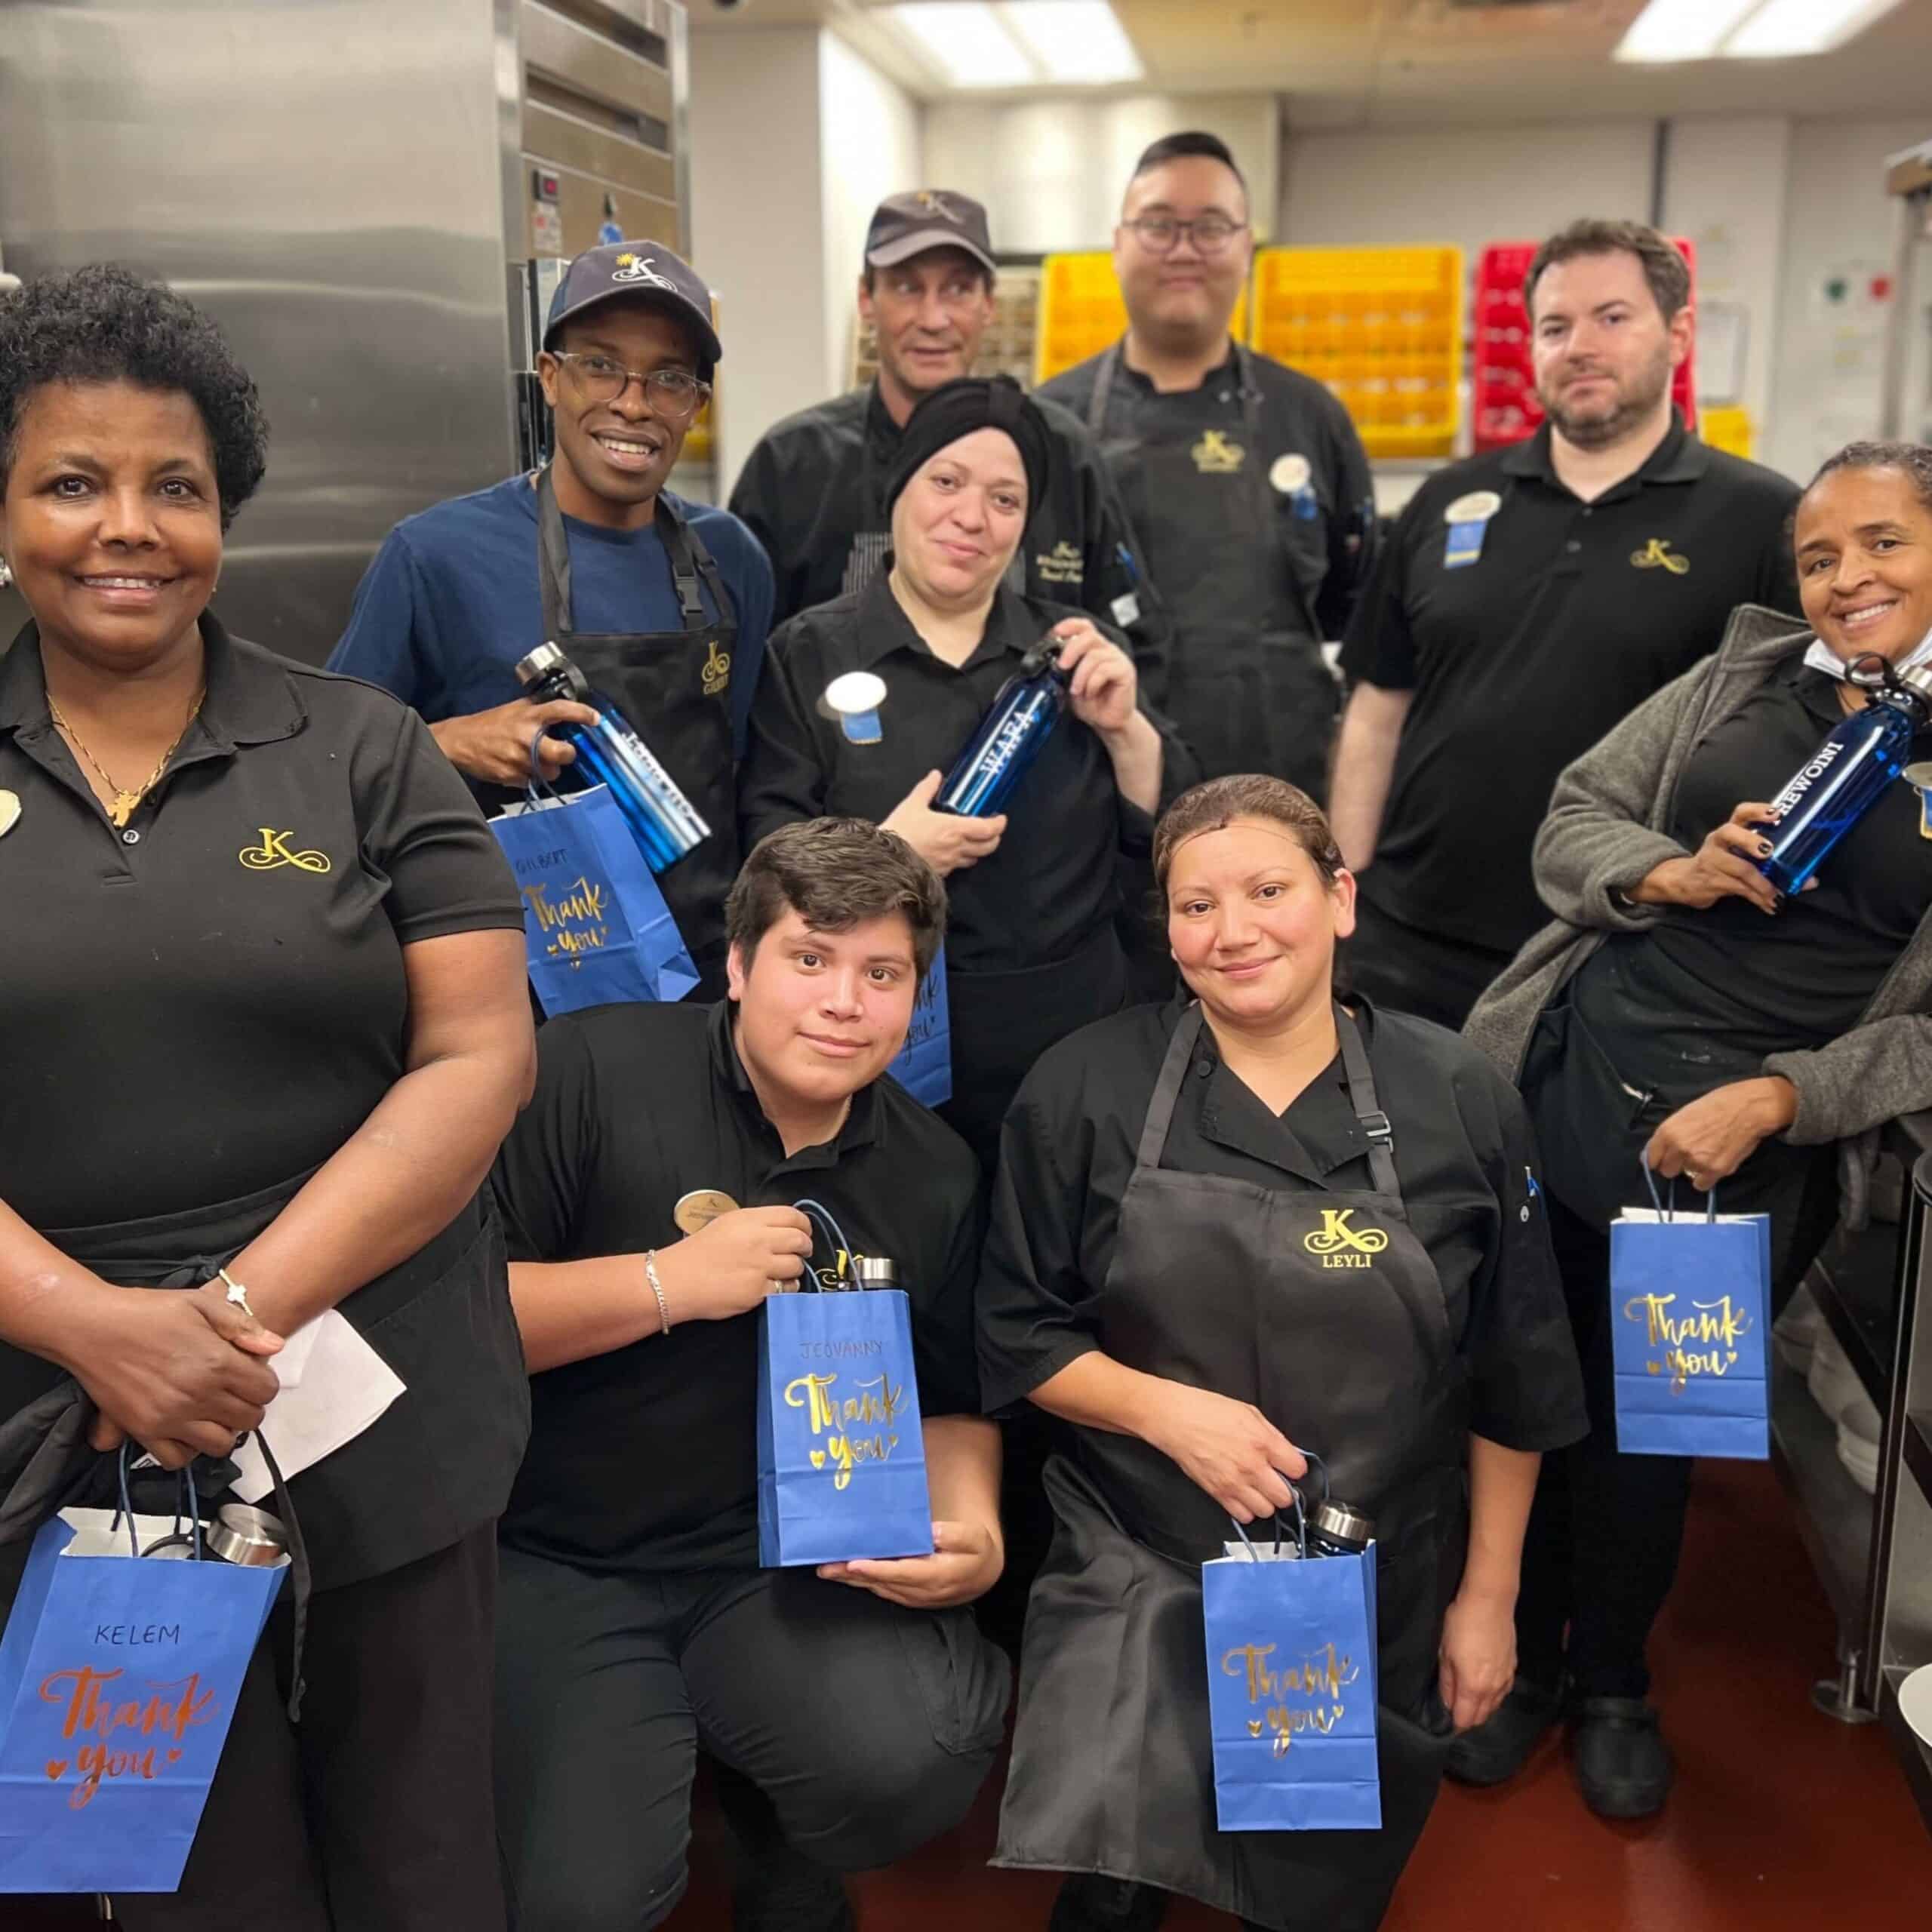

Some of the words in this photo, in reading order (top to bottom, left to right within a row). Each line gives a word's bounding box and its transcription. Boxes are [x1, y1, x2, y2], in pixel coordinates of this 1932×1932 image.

[1774, 741, 1844, 826] REWOINI
[238, 828, 331, 872] K
[522, 876, 609, 932] Thank
[556, 930, 604, 971] you
[1304, 1208, 1389, 1254] K
[1322, 1254, 1372, 1268] LEYLI
[1623, 1293, 1754, 1347] Thank
[798, 1339, 883, 1360] JEOVANNY
[1666, 1348, 1727, 1396] you
[784, 1373, 907, 1434] Thank
[828, 1435, 892, 1491] you
[94, 1624, 180, 1645] KELEM
[1221, 1641, 1359, 1704] Thank
[38, 1664, 220, 1740] Thank
[1266, 1704, 1335, 1760] you
[69, 1742, 165, 1810] you
